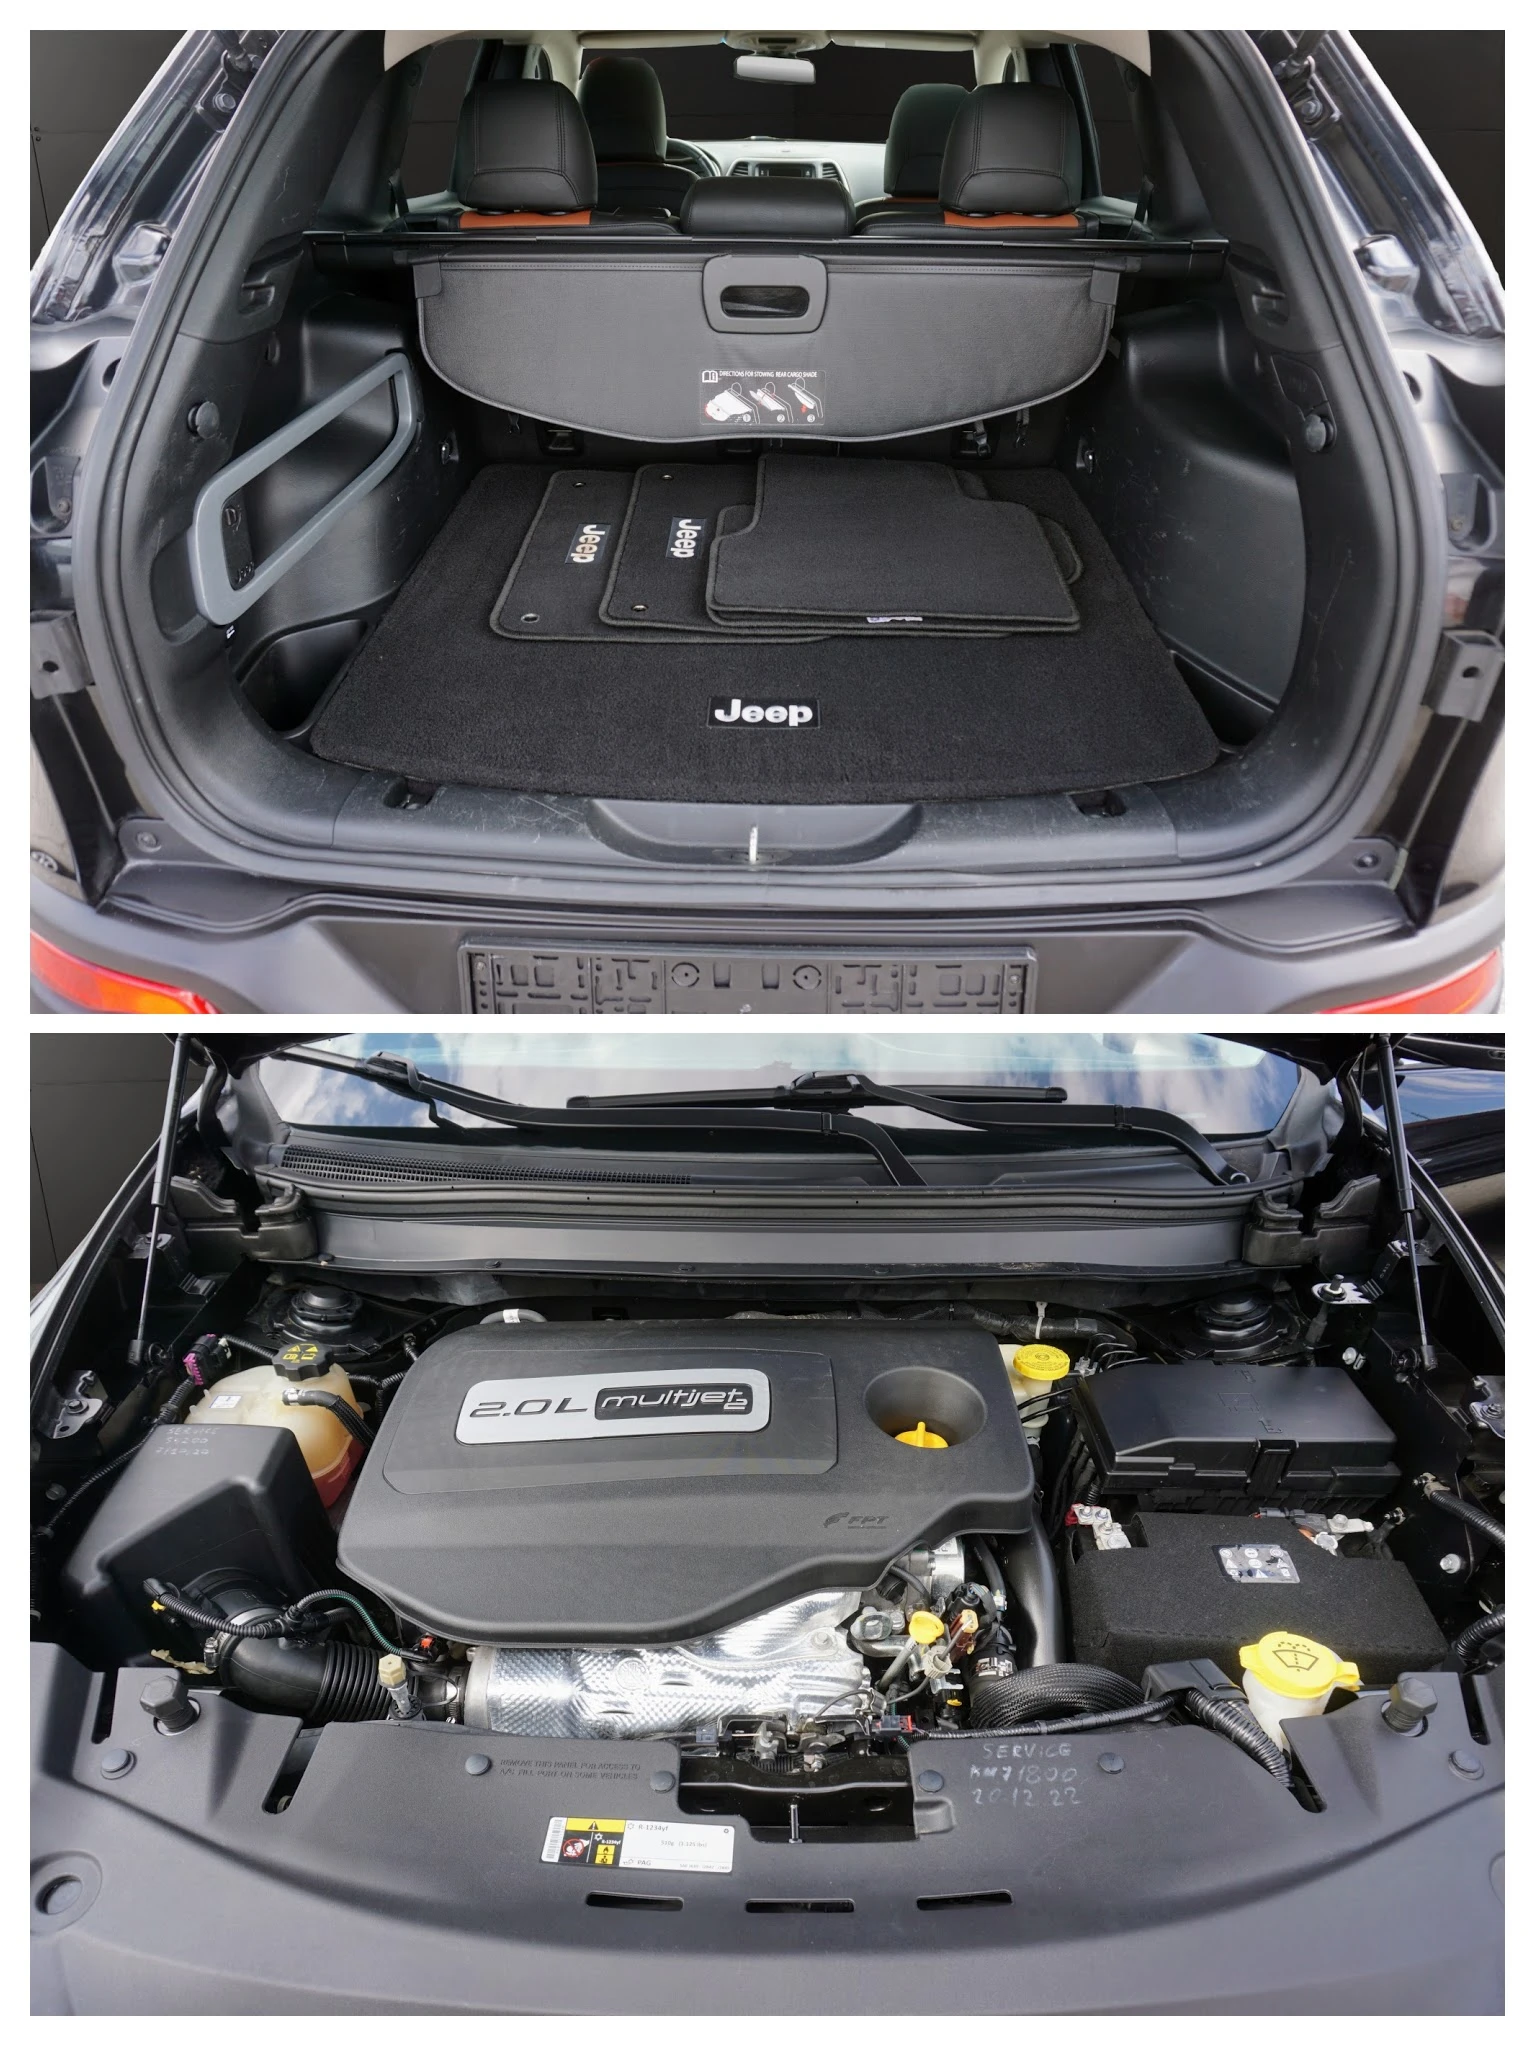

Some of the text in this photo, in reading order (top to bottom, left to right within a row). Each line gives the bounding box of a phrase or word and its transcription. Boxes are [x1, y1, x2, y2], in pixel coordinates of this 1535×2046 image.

[572, 528, 605, 563] Jeep
[671, 518, 701, 558] Jeep
[714, 698, 813, 727] Jeep
[600, 1388, 744, 1408] multijet
[848, 1516, 889, 1524] FPT
[500, 1759, 532, 1767] REMOVE
[534, 1760, 552, 1768] THIS
[553, 1761, 578, 1769] PANEL
[597, 1763, 629, 1771] ACCESS
[537, 1770, 558, 1778] PORT
[600, 1772, 639, 1780] VEHICLES
